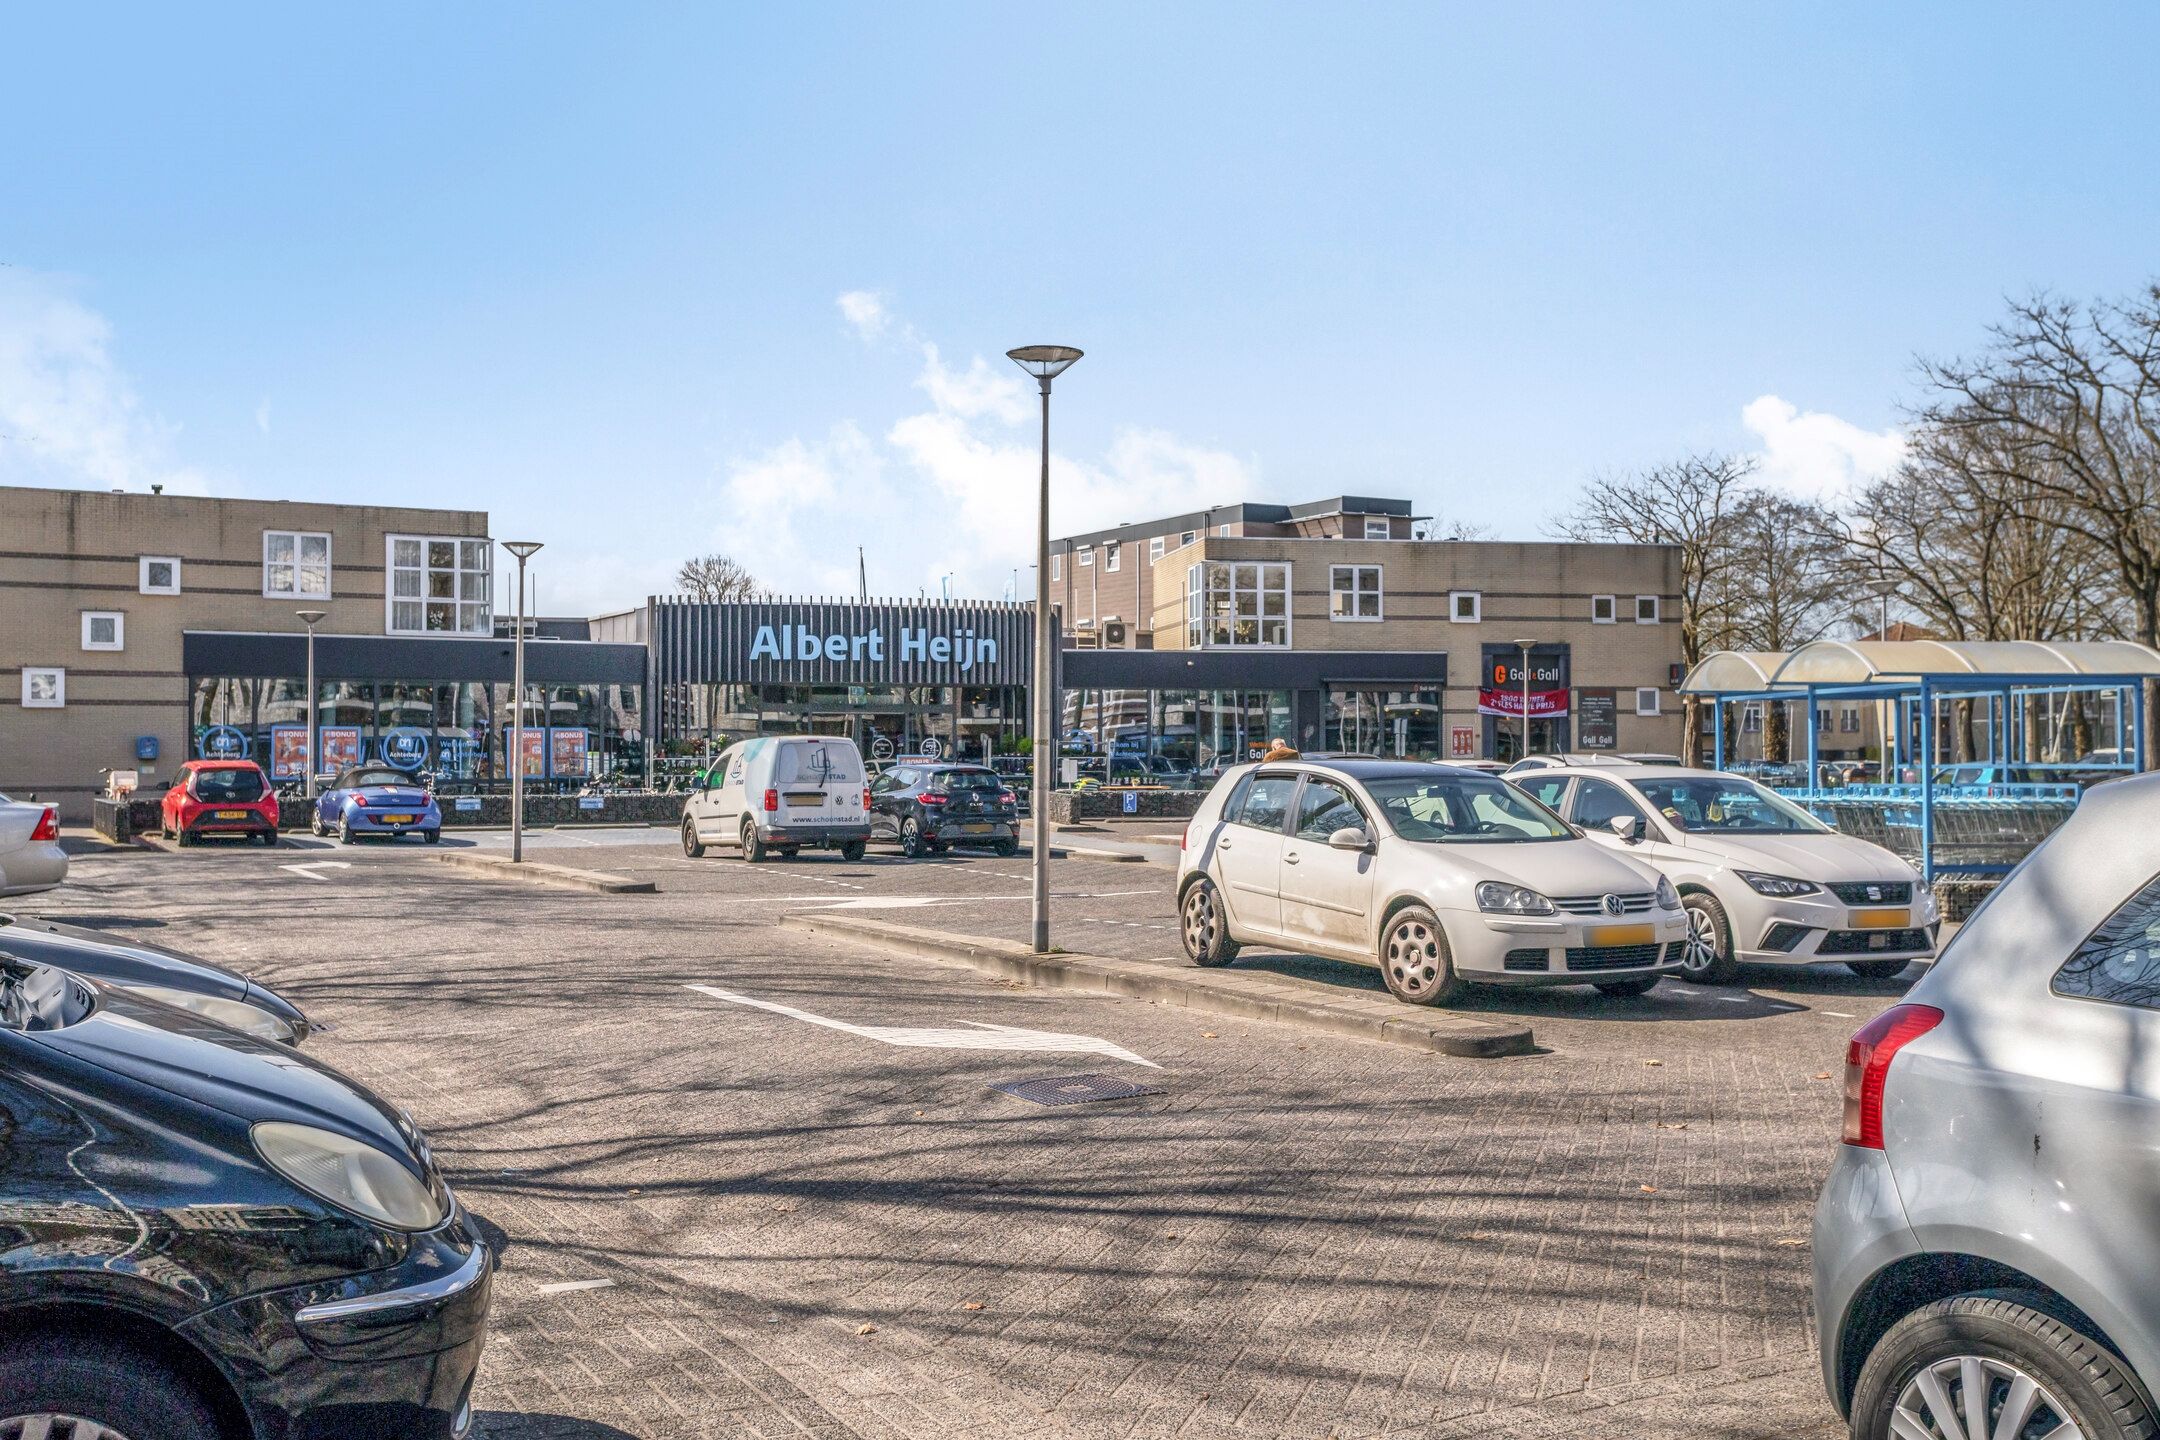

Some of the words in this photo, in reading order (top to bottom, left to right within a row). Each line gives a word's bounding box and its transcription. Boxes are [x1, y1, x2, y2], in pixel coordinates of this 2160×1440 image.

[750, 624, 883, 661] Albert
[901, 627, 997, 671] Heijn
[1510, 668, 1531, 681] Gal
[1537, 668, 1559, 681] Gall
